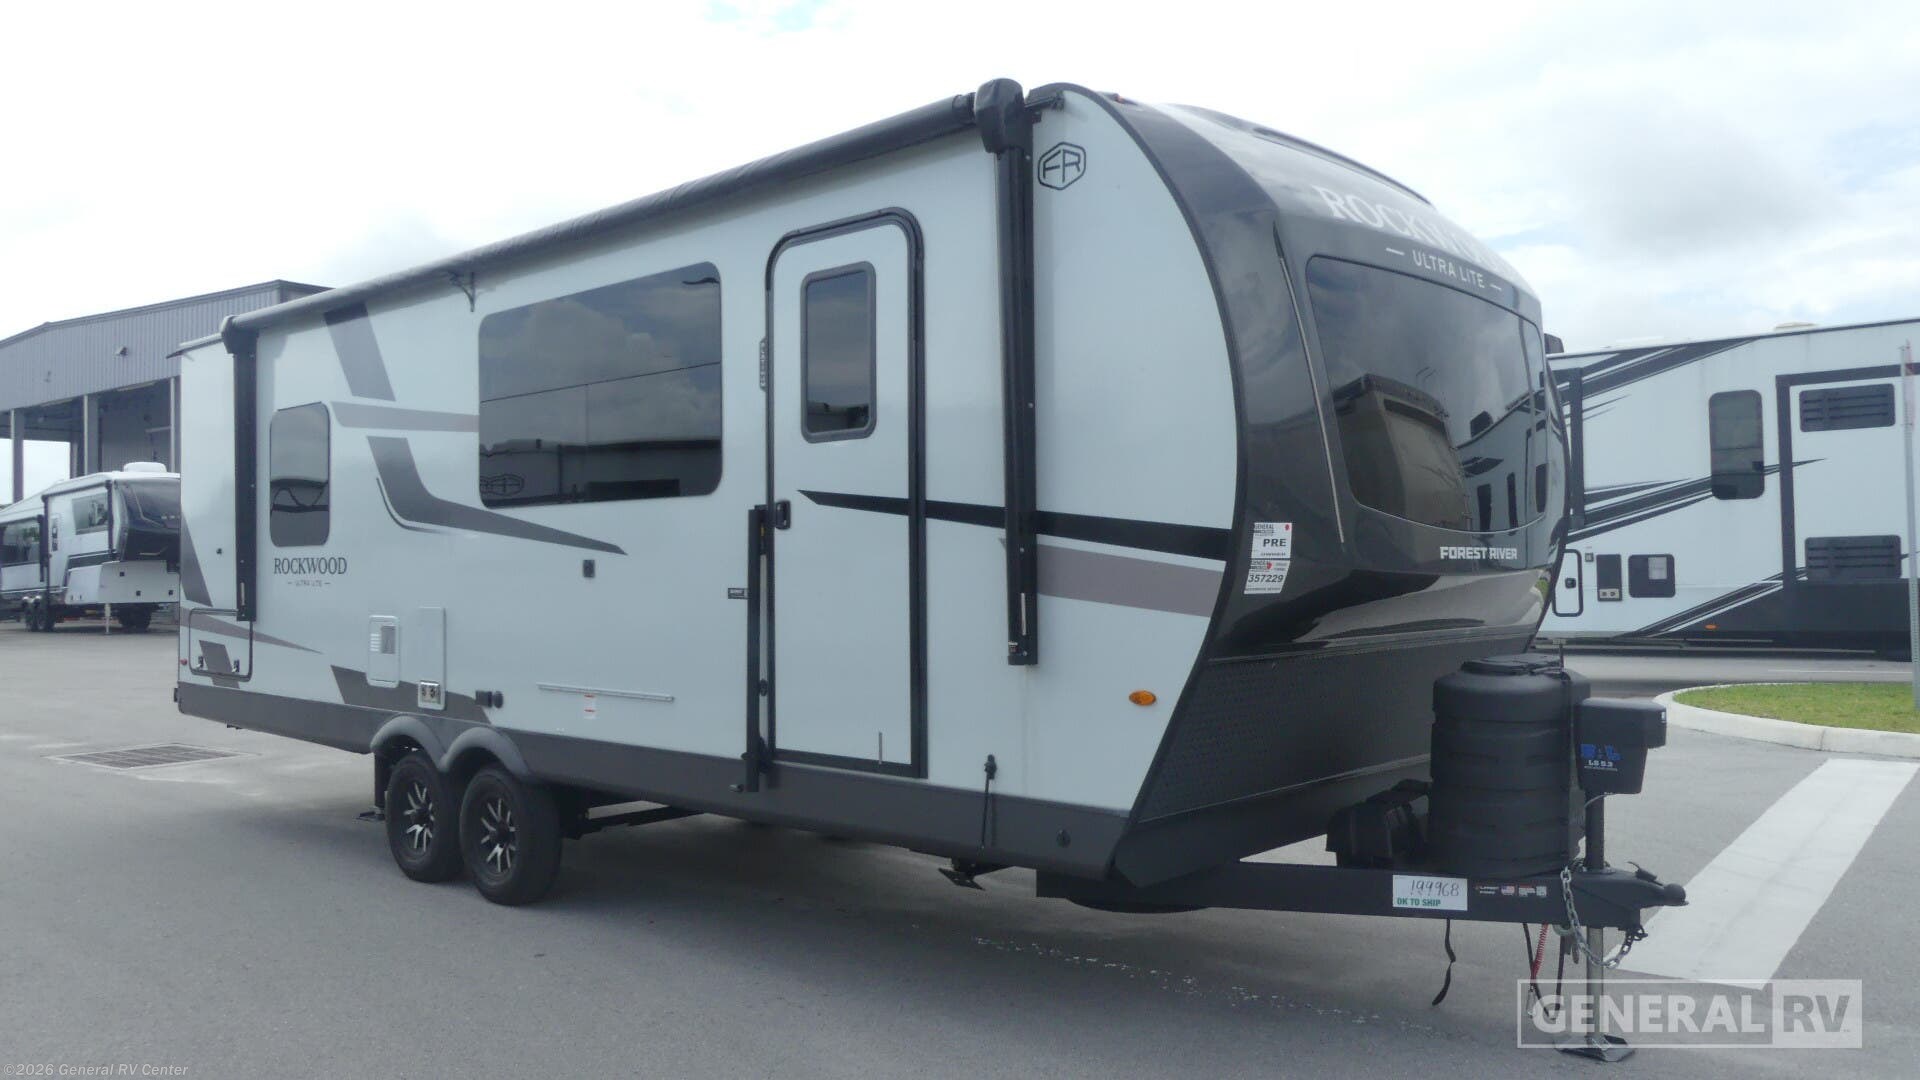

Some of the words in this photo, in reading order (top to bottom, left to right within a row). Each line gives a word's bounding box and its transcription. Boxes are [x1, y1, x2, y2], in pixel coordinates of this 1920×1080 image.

[1412, 250, 1456, 278] ULTRA
[1459, 266, 1485, 288] LITE
[1263, 538, 1287, 547] PRE
[1440, 546, 1487, 560] FOREST
[1489, 547, 1518, 560] RIVER
[274, 557, 347, 574] ROCKWOOD
[1248, 574, 1284, 583] 357229
[1397, 897, 1408, 905] OK
[1410, 898, 1420, 906] TO
[1422, 898, 1441, 907] SHIP
